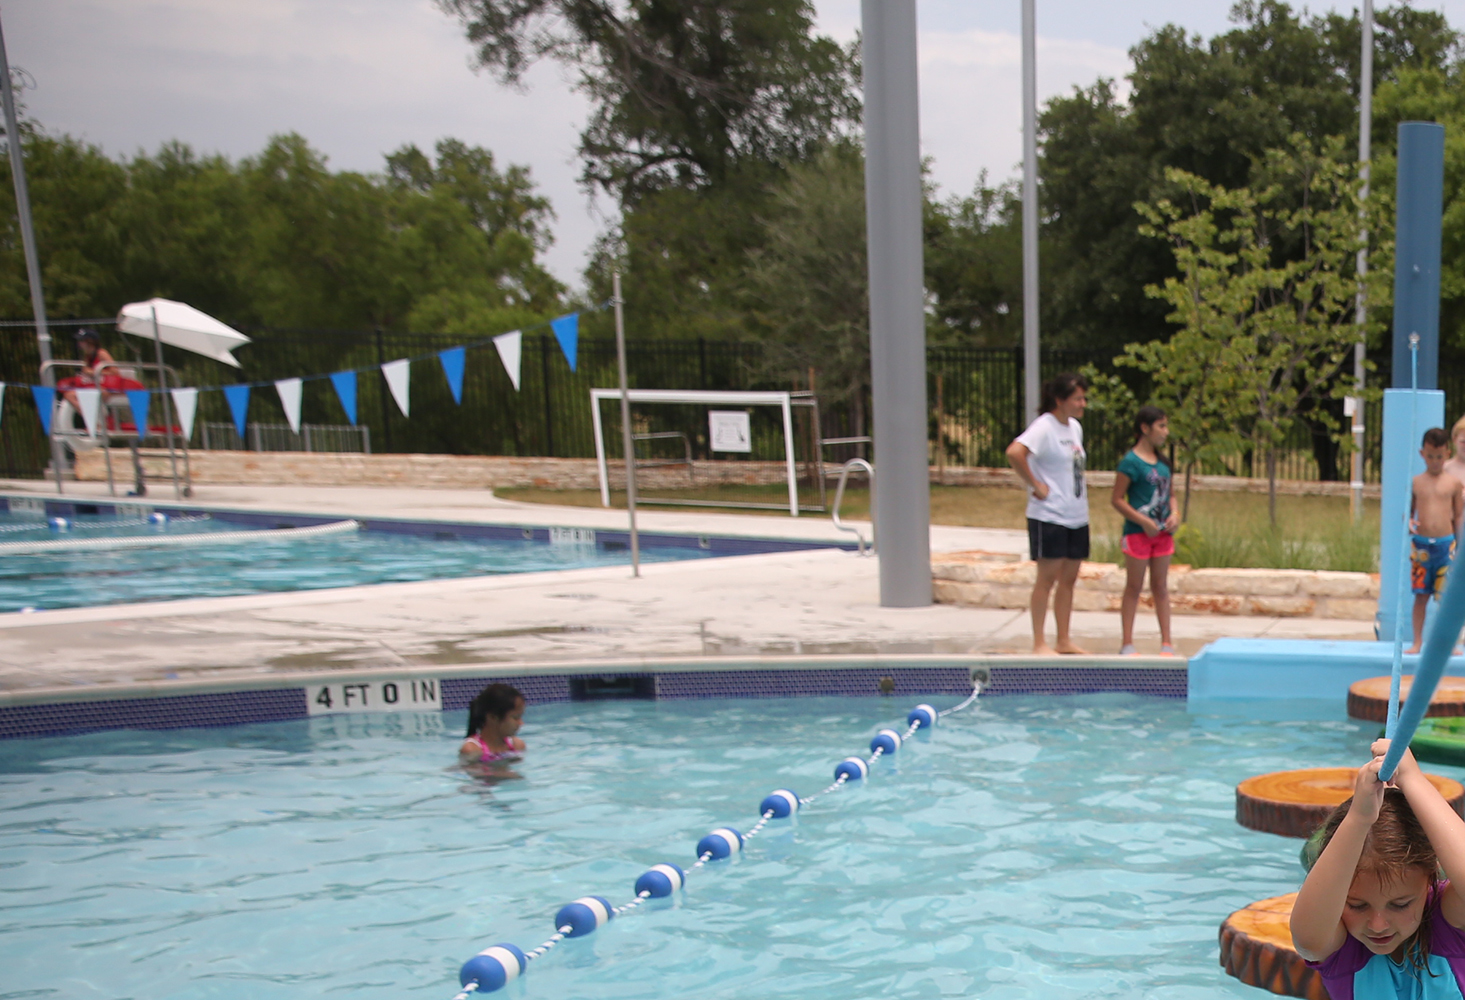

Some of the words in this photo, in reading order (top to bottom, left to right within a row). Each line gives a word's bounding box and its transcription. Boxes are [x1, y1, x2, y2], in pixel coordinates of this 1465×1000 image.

[317, 686, 333, 708] 4
[343, 684, 371, 707] FT
[382, 683, 399, 704] 0
[411, 681, 436, 702] IN
